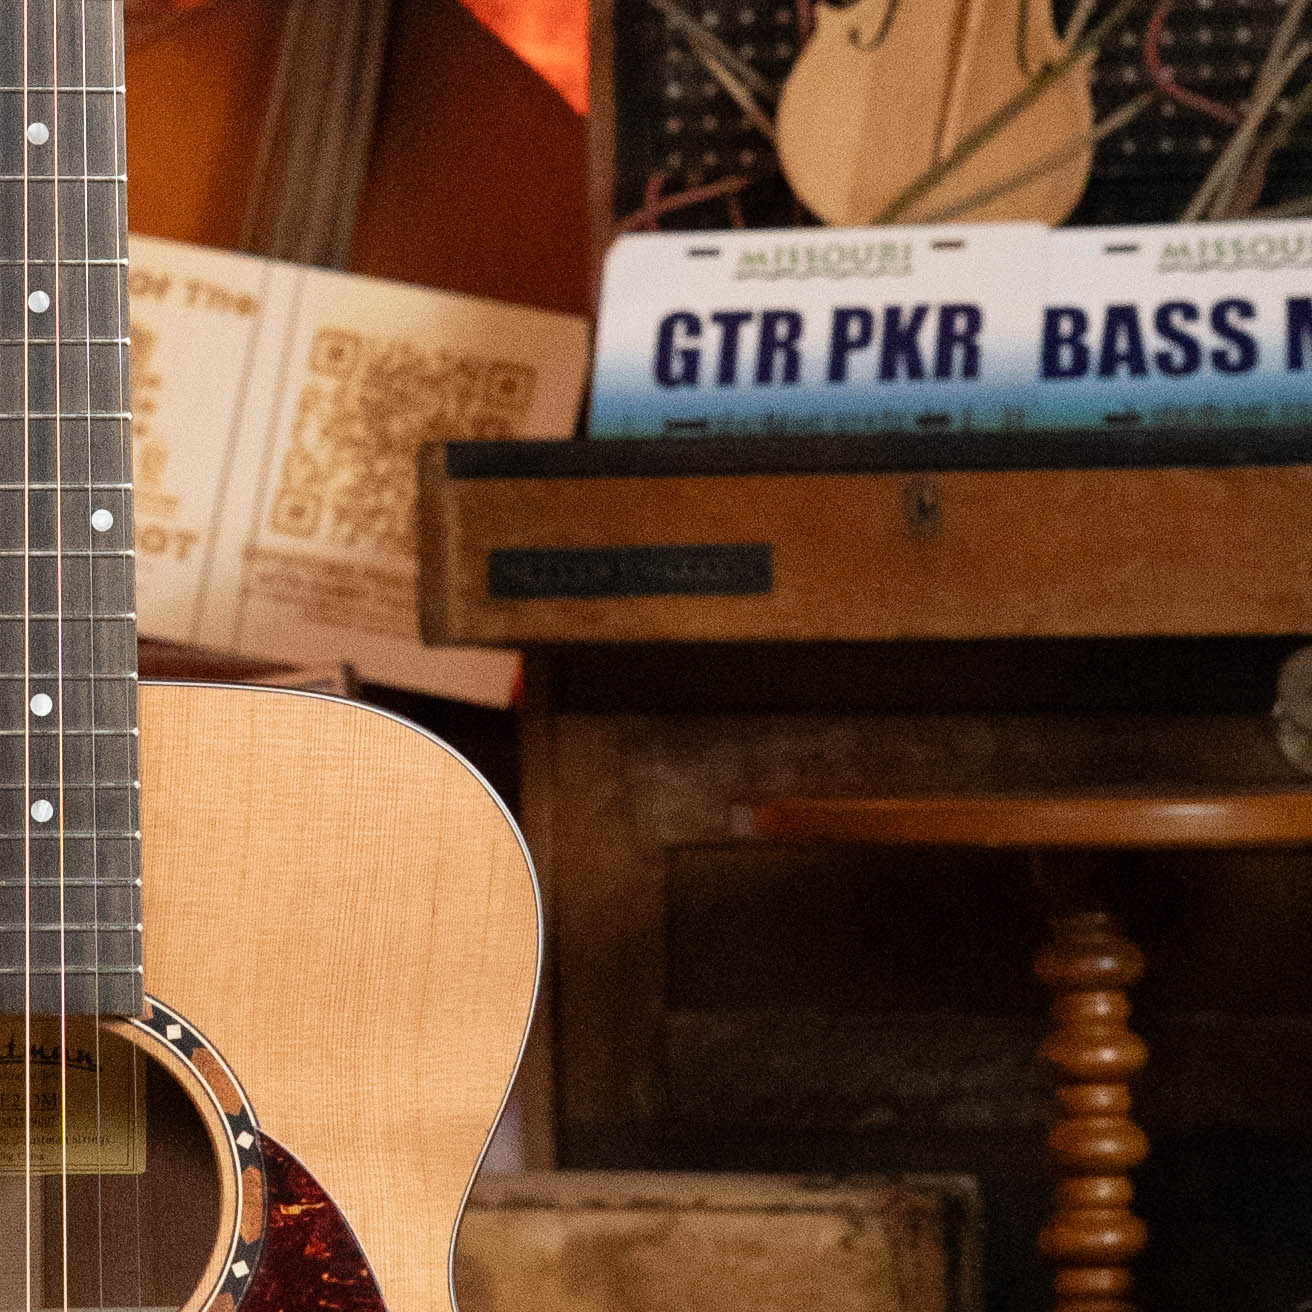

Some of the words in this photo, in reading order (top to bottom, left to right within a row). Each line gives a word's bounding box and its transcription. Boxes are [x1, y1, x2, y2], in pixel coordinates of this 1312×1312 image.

[737, 239, 914, 277] MISSOURI
[1159, 233, 1312, 271] MISSOU
[654, 309, 804, 387] GTR
[827, 302, 983, 385] PKR
[1040, 297, 1259, 381] BASS
